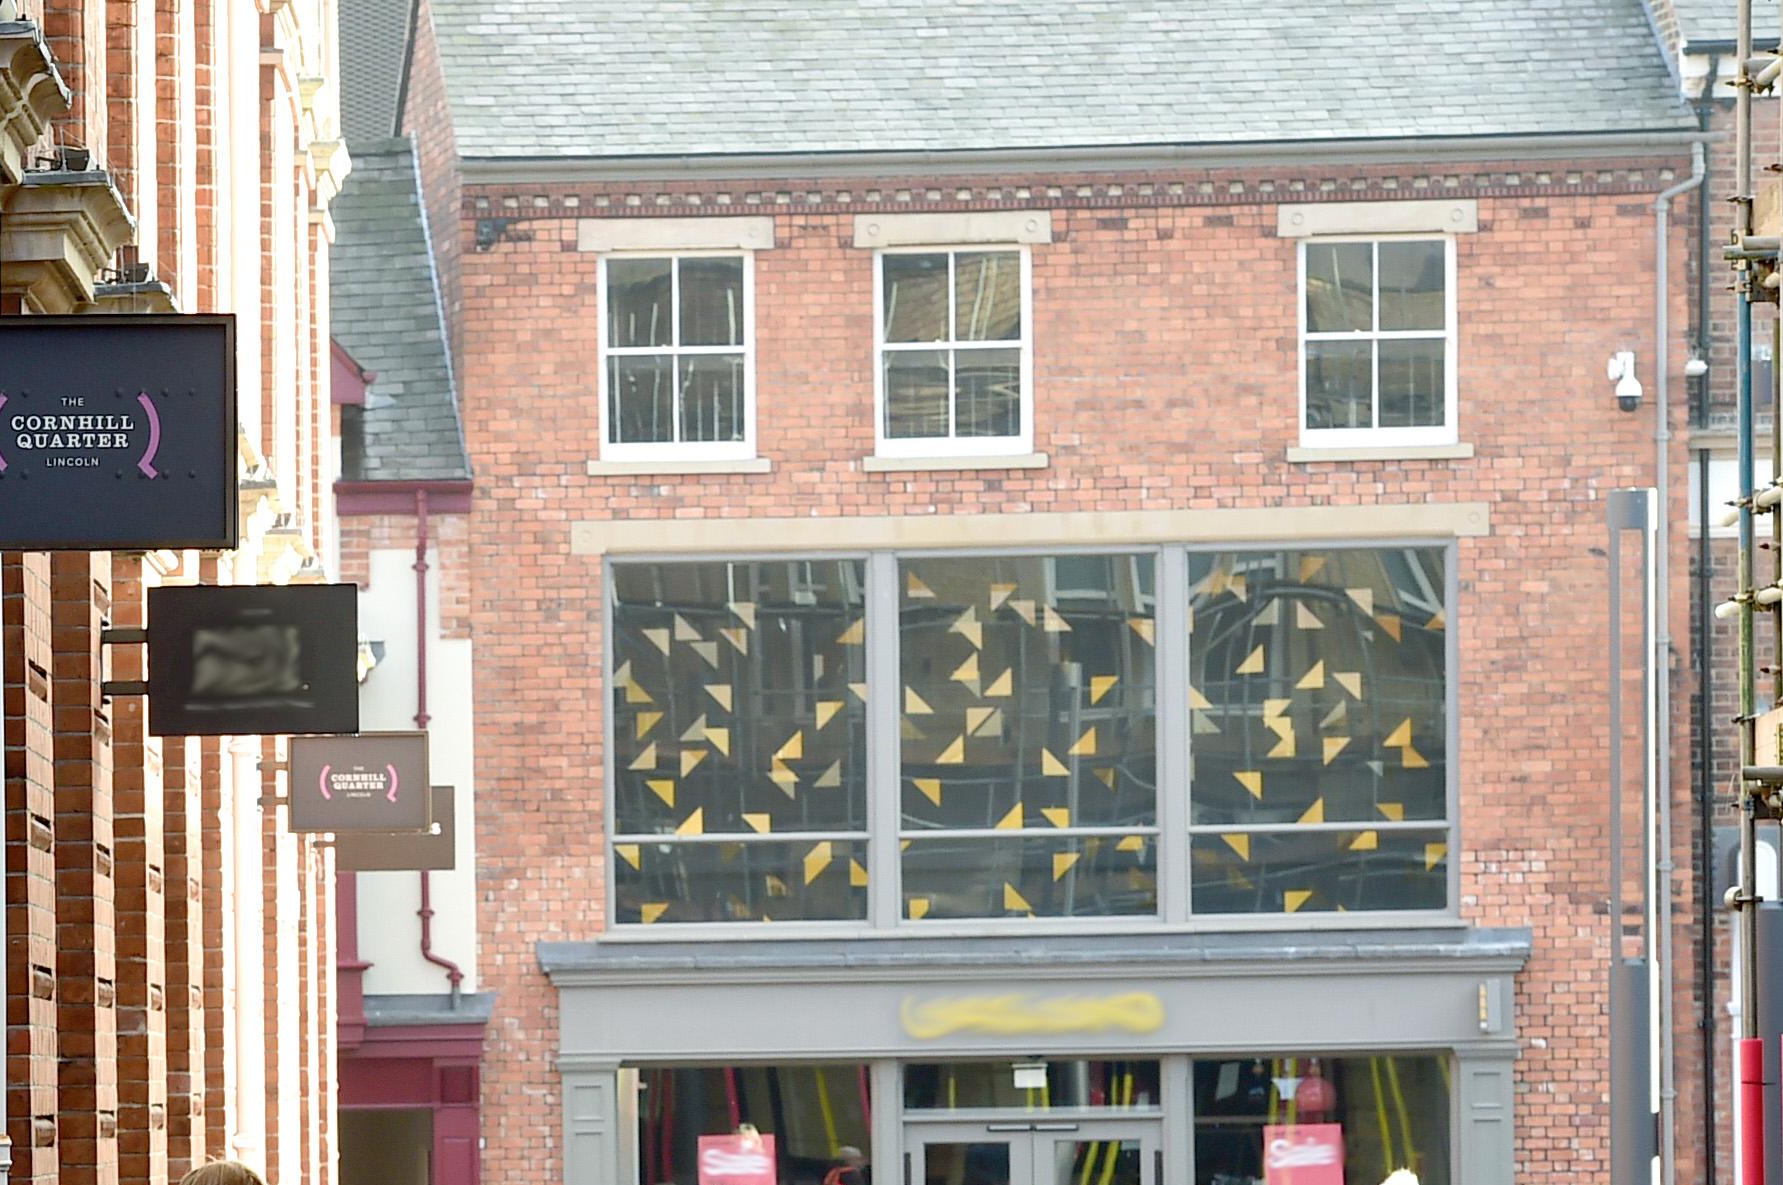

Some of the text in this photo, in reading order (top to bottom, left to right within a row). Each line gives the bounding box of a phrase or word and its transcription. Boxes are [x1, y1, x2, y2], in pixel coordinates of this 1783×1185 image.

[61, 397, 85, 407] THE
[11, 415, 134, 431] CORNHILL
[16, 433, 129, 450] QUARTER
[46, 457, 100, 467] LINCOLN
[331, 773, 387, 782] CORNHILL
[333, 782, 384, 790] QUARTER
